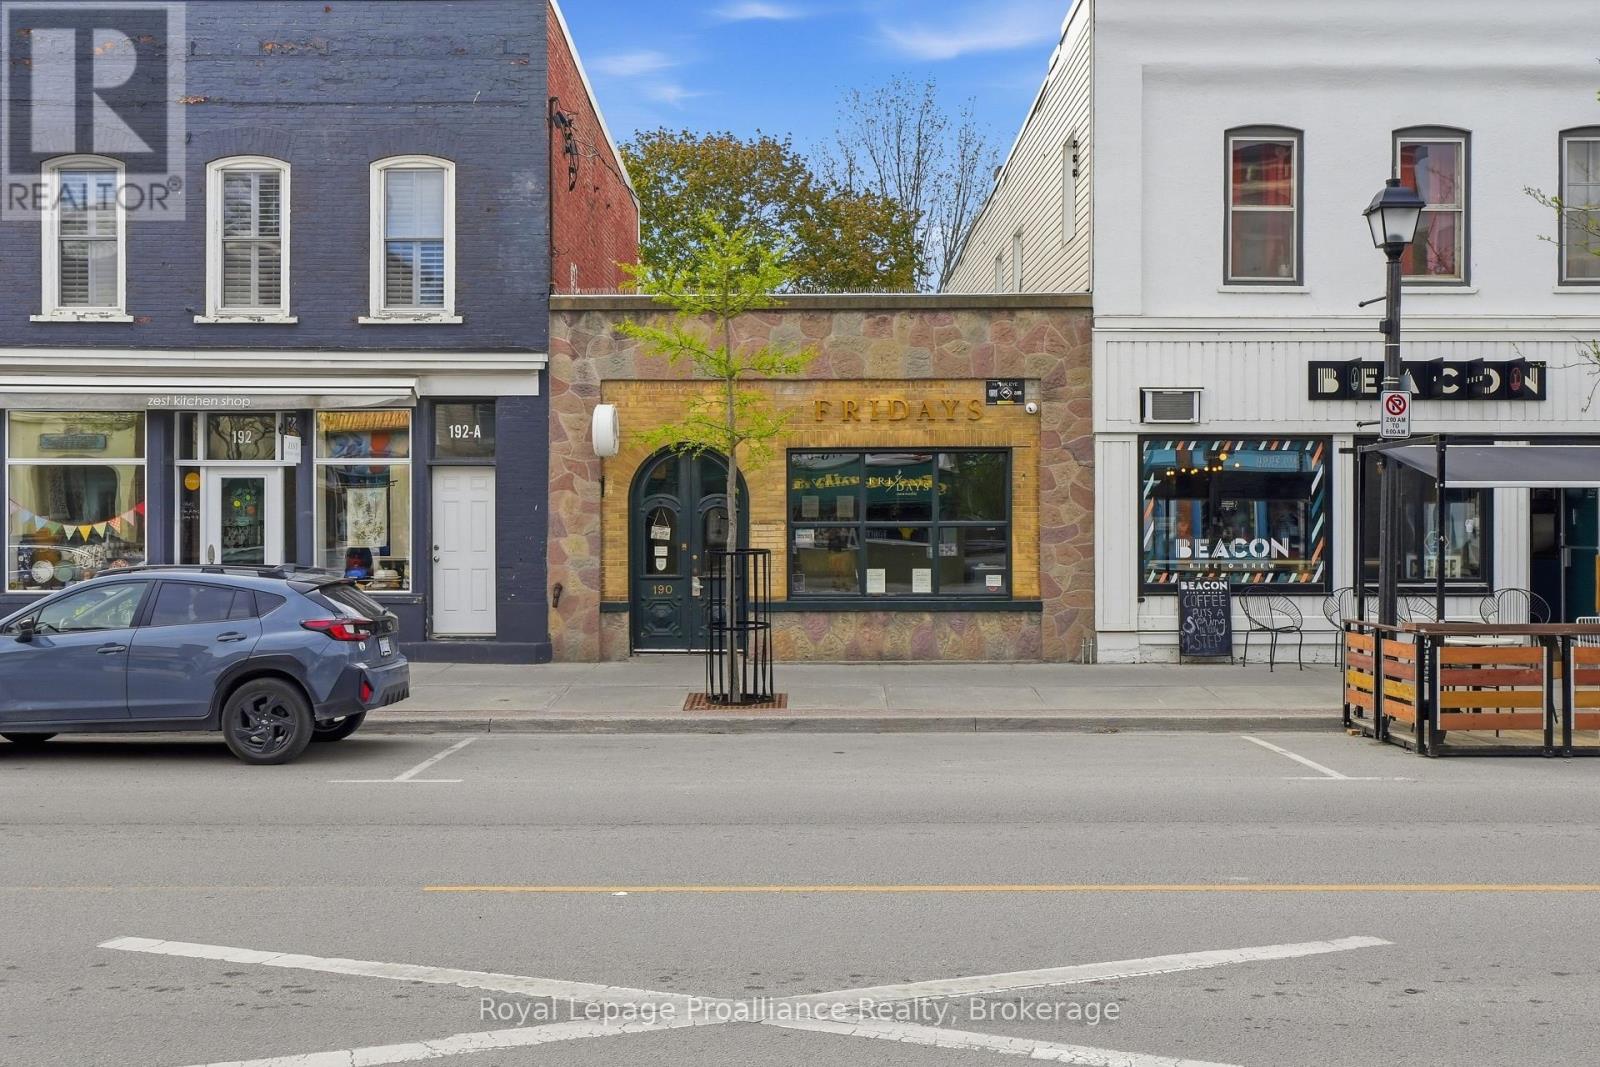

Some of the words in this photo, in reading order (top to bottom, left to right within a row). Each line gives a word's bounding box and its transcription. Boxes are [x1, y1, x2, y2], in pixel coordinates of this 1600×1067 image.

[147, 396, 170, 406] zest
[173, 395, 218, 406] kitchen
[221, 395, 251, 408] shop
[814, 399, 984, 422] FRIDAYS
[232, 430, 252, 444] 192
[449, 424, 481, 439] 192-A
[1175, 537, 1289, 559] BEACON
[653, 584, 673, 595] 190
[1180, 581, 1228, 590] BEACON
[1183, 594, 1227, 608] COFFEE
[1216, 608, 1224, 617] A
